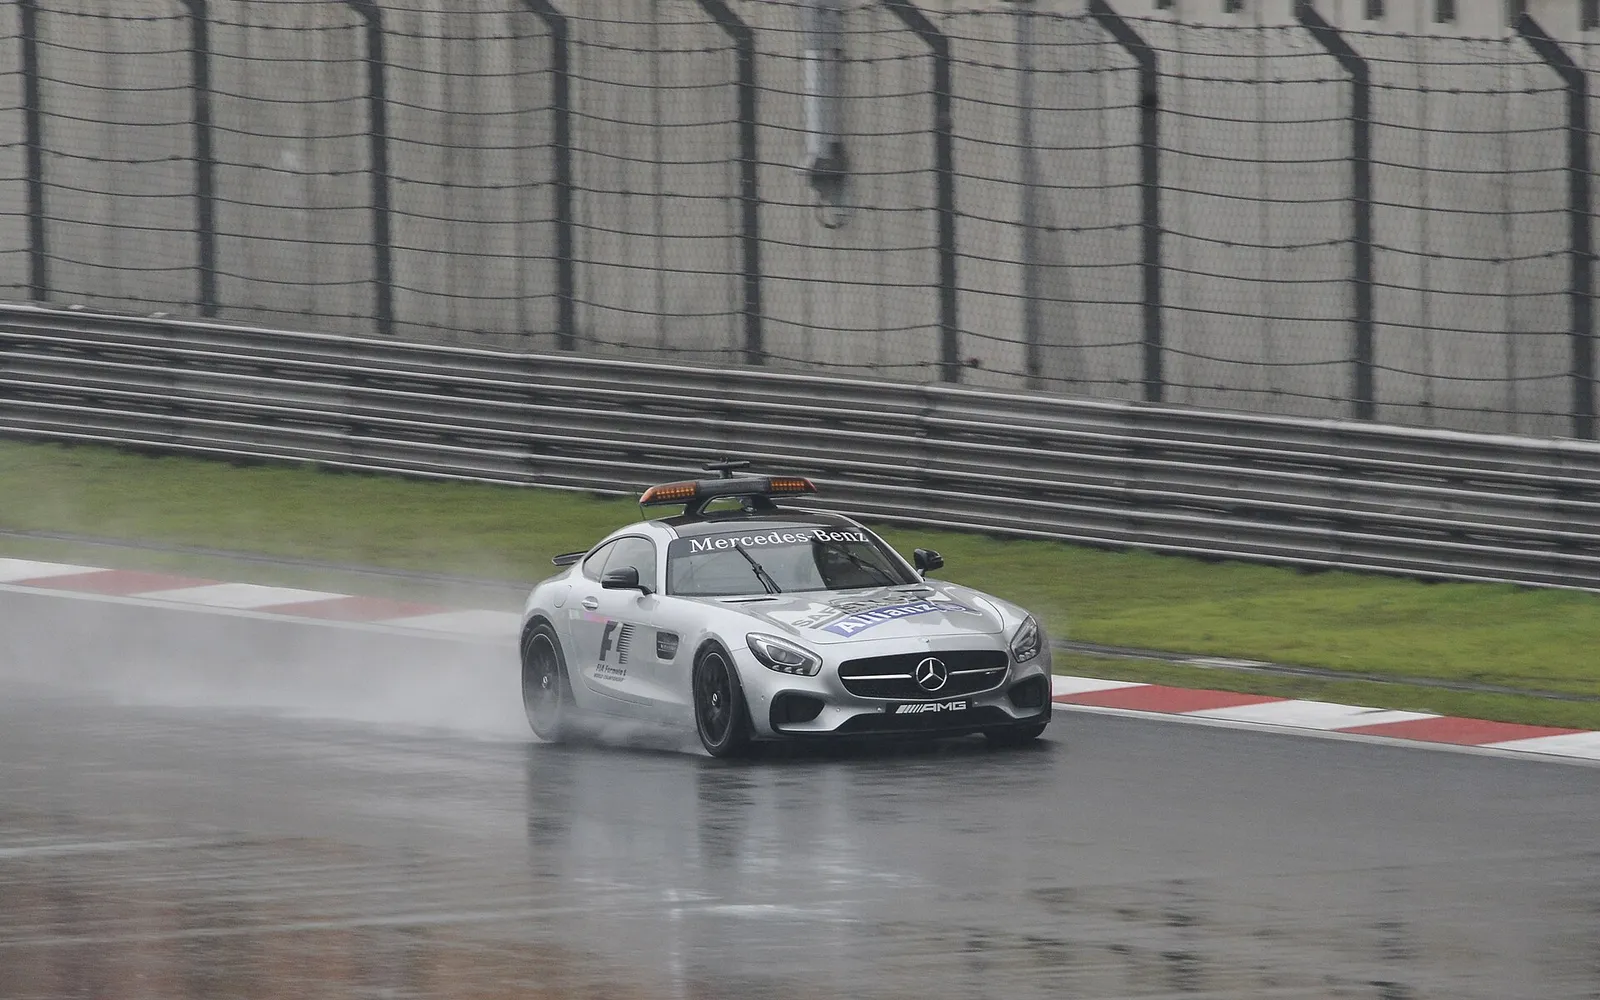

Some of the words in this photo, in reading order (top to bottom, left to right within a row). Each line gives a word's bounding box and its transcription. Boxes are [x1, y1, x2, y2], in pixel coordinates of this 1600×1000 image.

[689, 529, 870, 553] Mercedes-Benz
[833, 602, 938, 633] Allianz
[599, 620, 637, 664] F1
[920, 701, 967, 712] AMG
